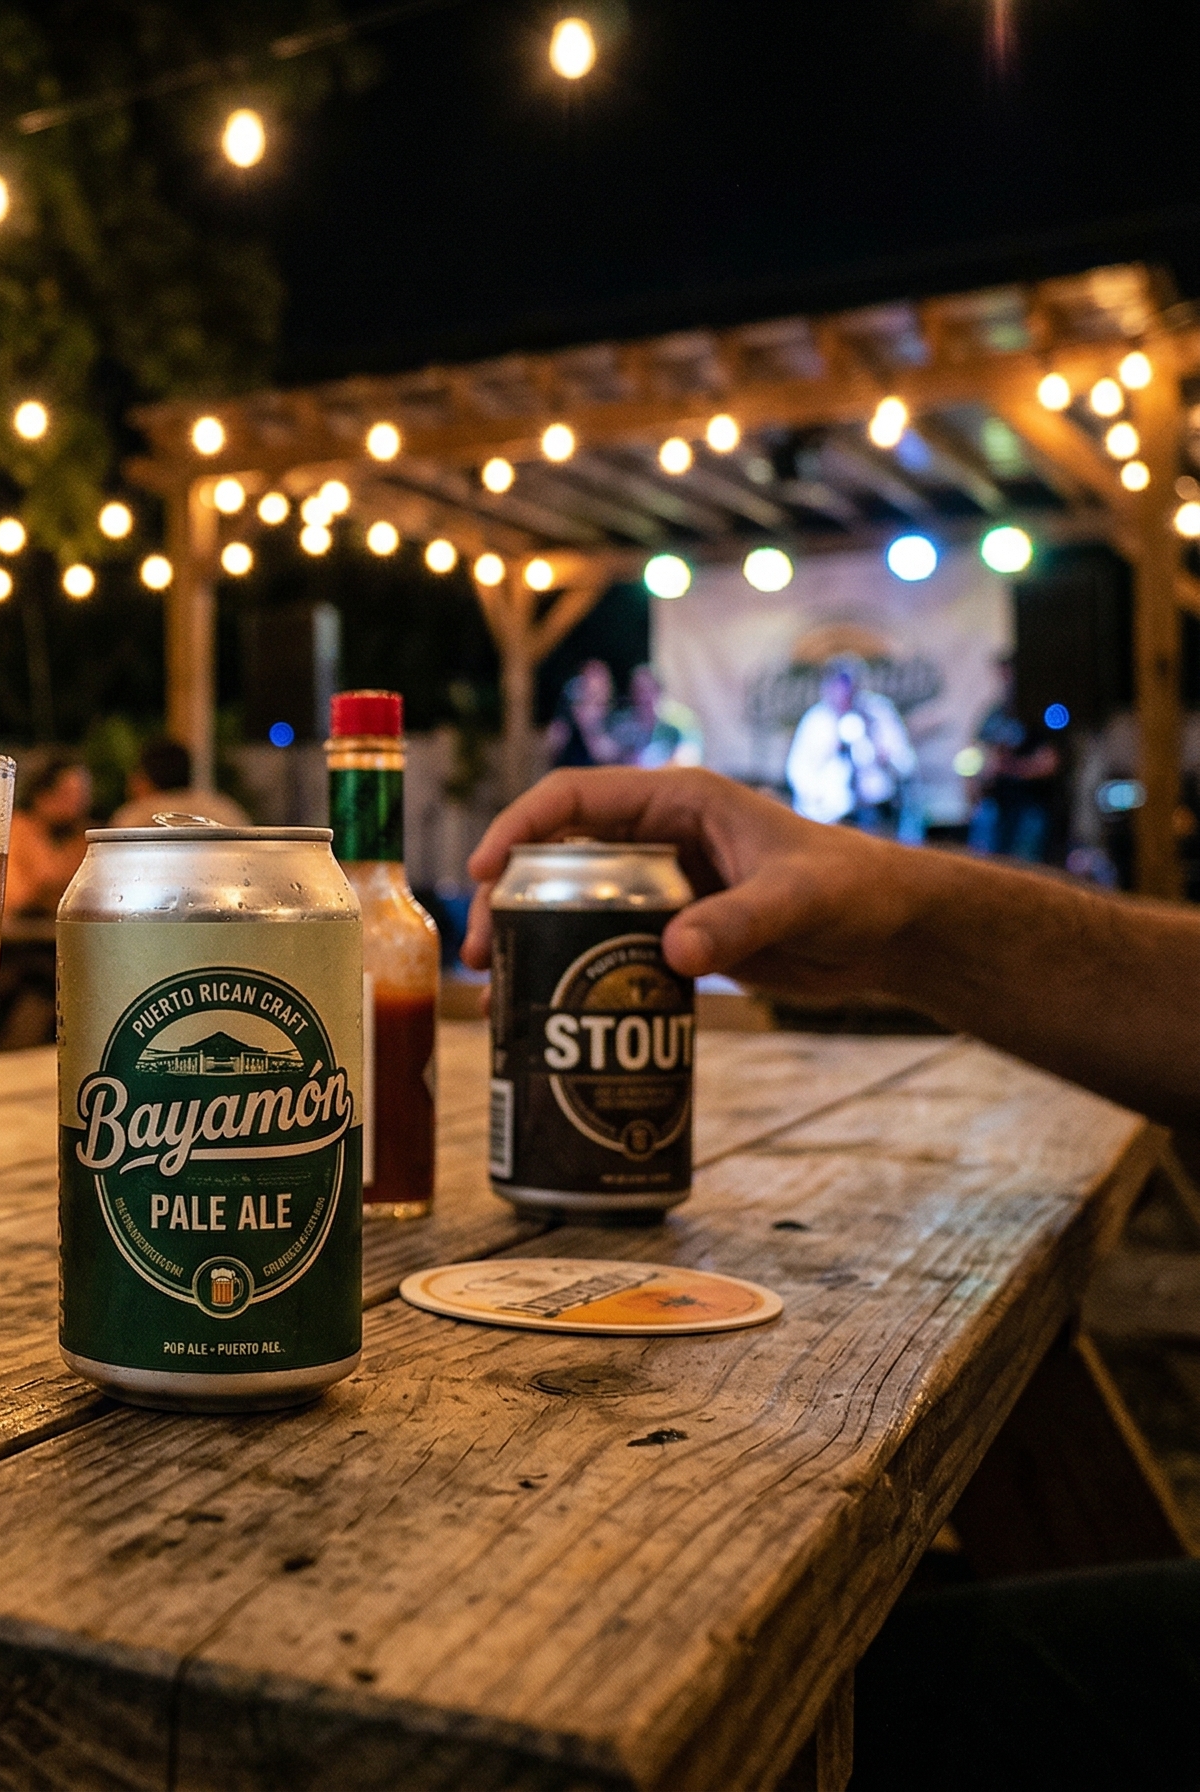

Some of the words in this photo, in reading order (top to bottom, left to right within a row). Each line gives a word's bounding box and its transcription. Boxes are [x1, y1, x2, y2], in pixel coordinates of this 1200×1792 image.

[131, 986, 195, 1038] PUERTO
[198, 981, 257, 1006] RICAN
[259, 992, 310, 1035] CRAFT
[75, 1060, 350, 1176] Bayamón
[151, 1194, 227, 1231] PALE
[237, 1193, 292, 1230] ALE
[187, 1342, 209, 1355] ALE
[217, 1342, 260, 1355] PUERTO
